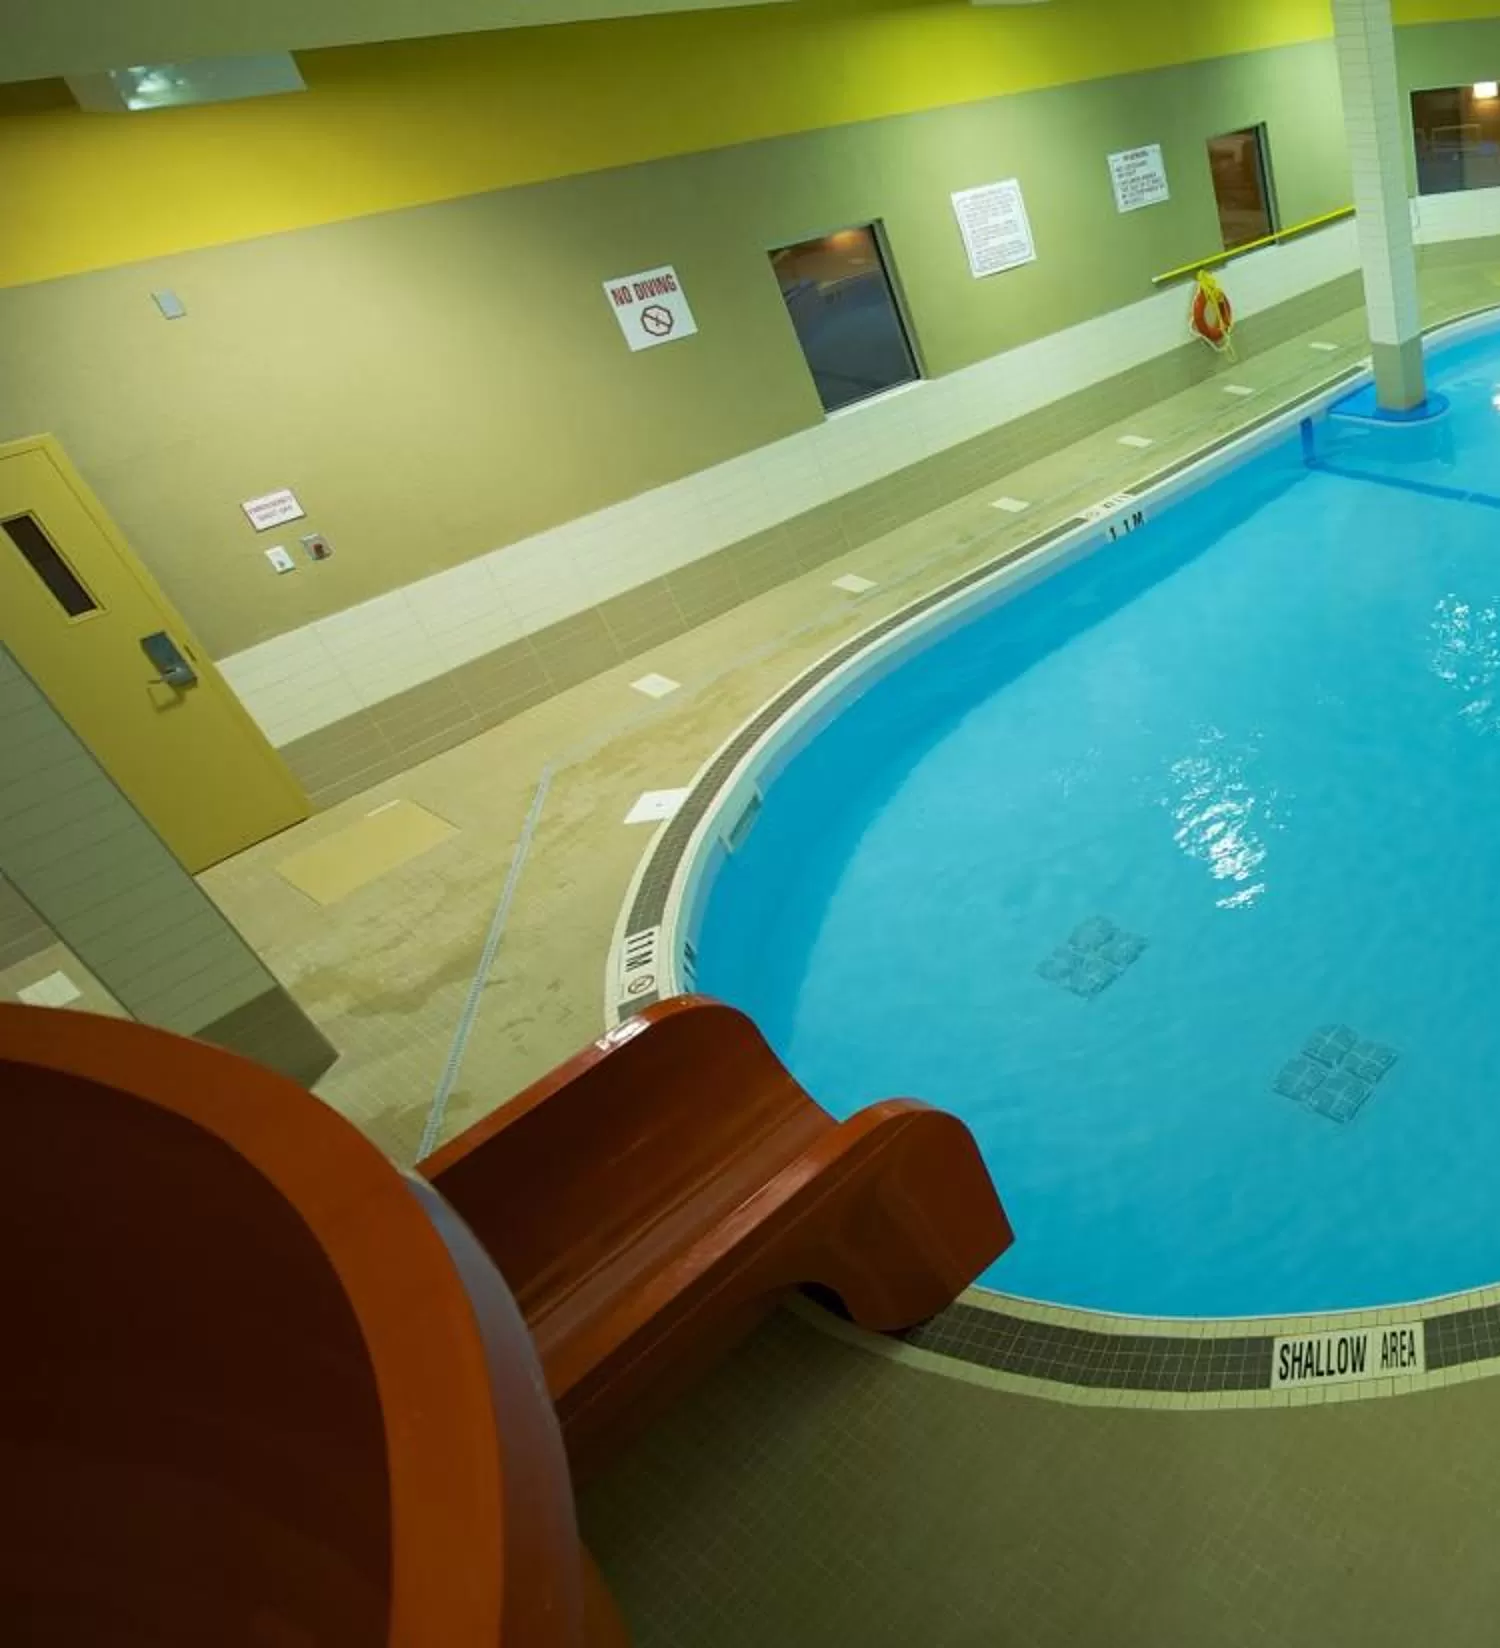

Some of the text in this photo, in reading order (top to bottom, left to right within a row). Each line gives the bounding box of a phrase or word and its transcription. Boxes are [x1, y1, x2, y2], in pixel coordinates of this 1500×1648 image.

[611, 273, 677, 306] NO DIVING
[1279, 1329, 1417, 1380] SHALLOW AREA
